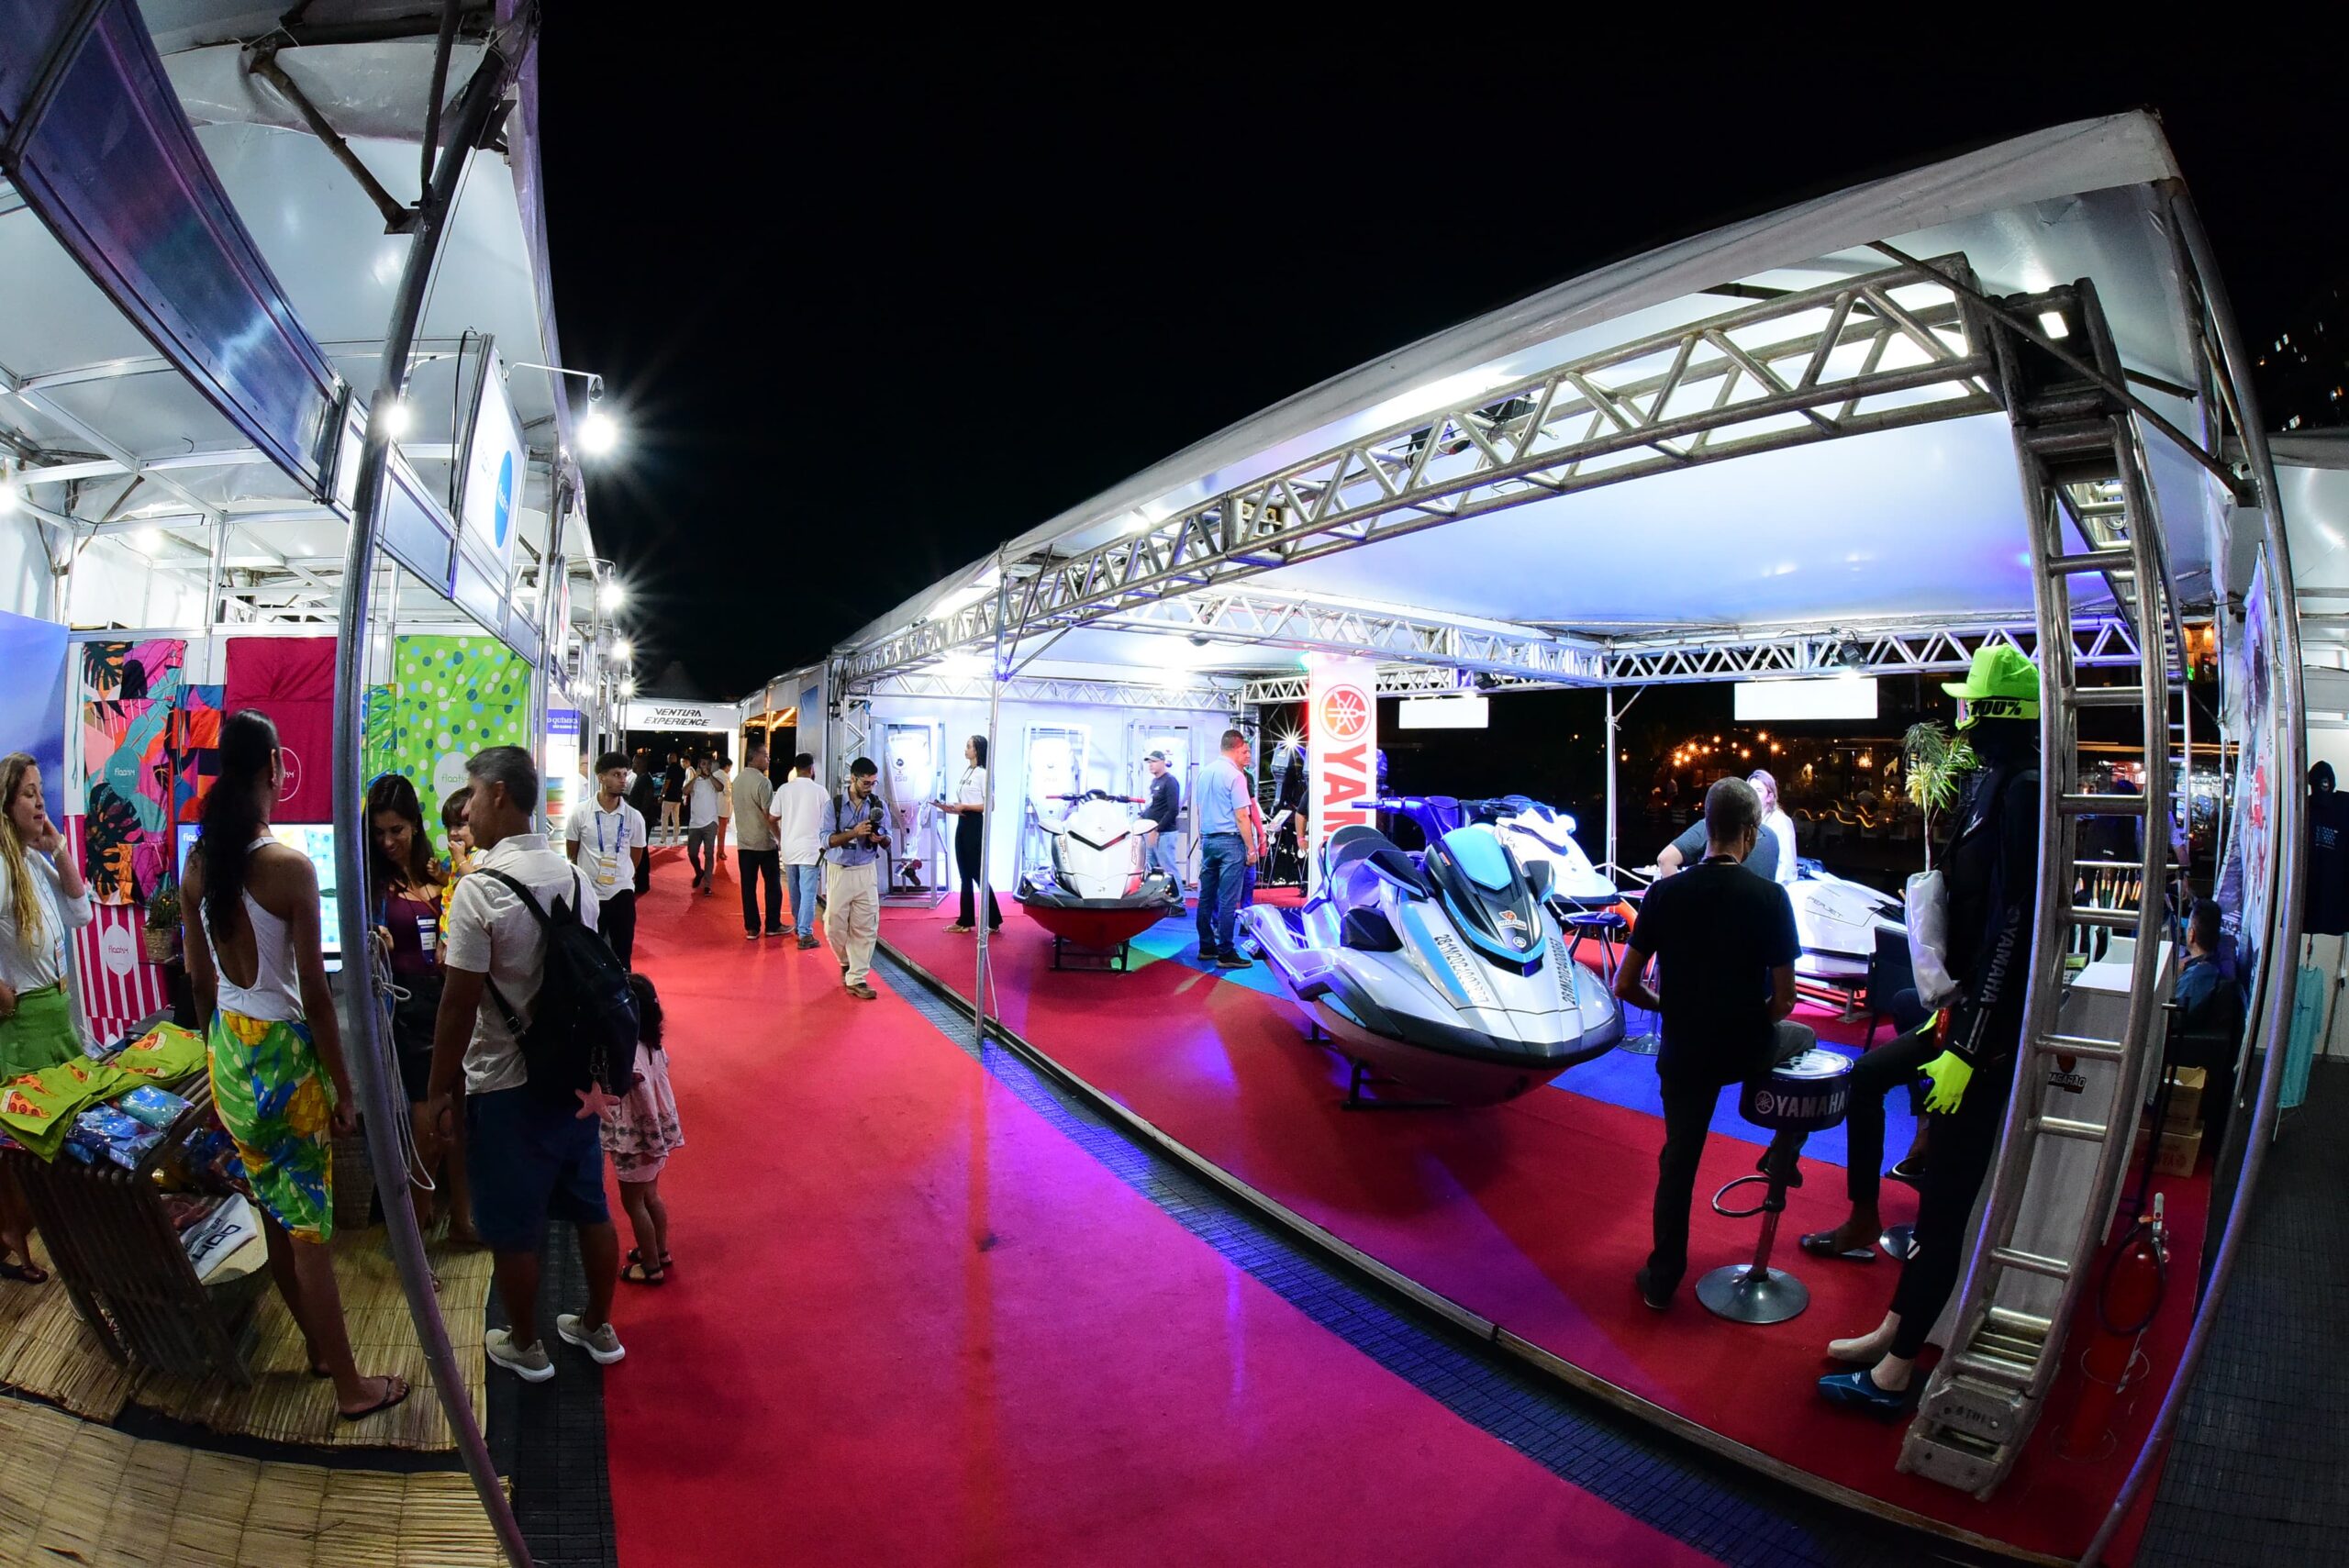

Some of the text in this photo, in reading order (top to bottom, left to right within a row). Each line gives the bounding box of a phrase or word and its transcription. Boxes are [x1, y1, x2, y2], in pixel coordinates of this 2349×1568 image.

[654, 707, 702, 717] VENTURA
[1969, 700, 2022, 717] 100%
[643, 717, 711, 726] EXPERIENCE
[1323, 743, 1366, 840] YAM
[1979, 926, 2020, 1004] YAMAHA
[1776, 1090, 1847, 1118] YAMAHA
